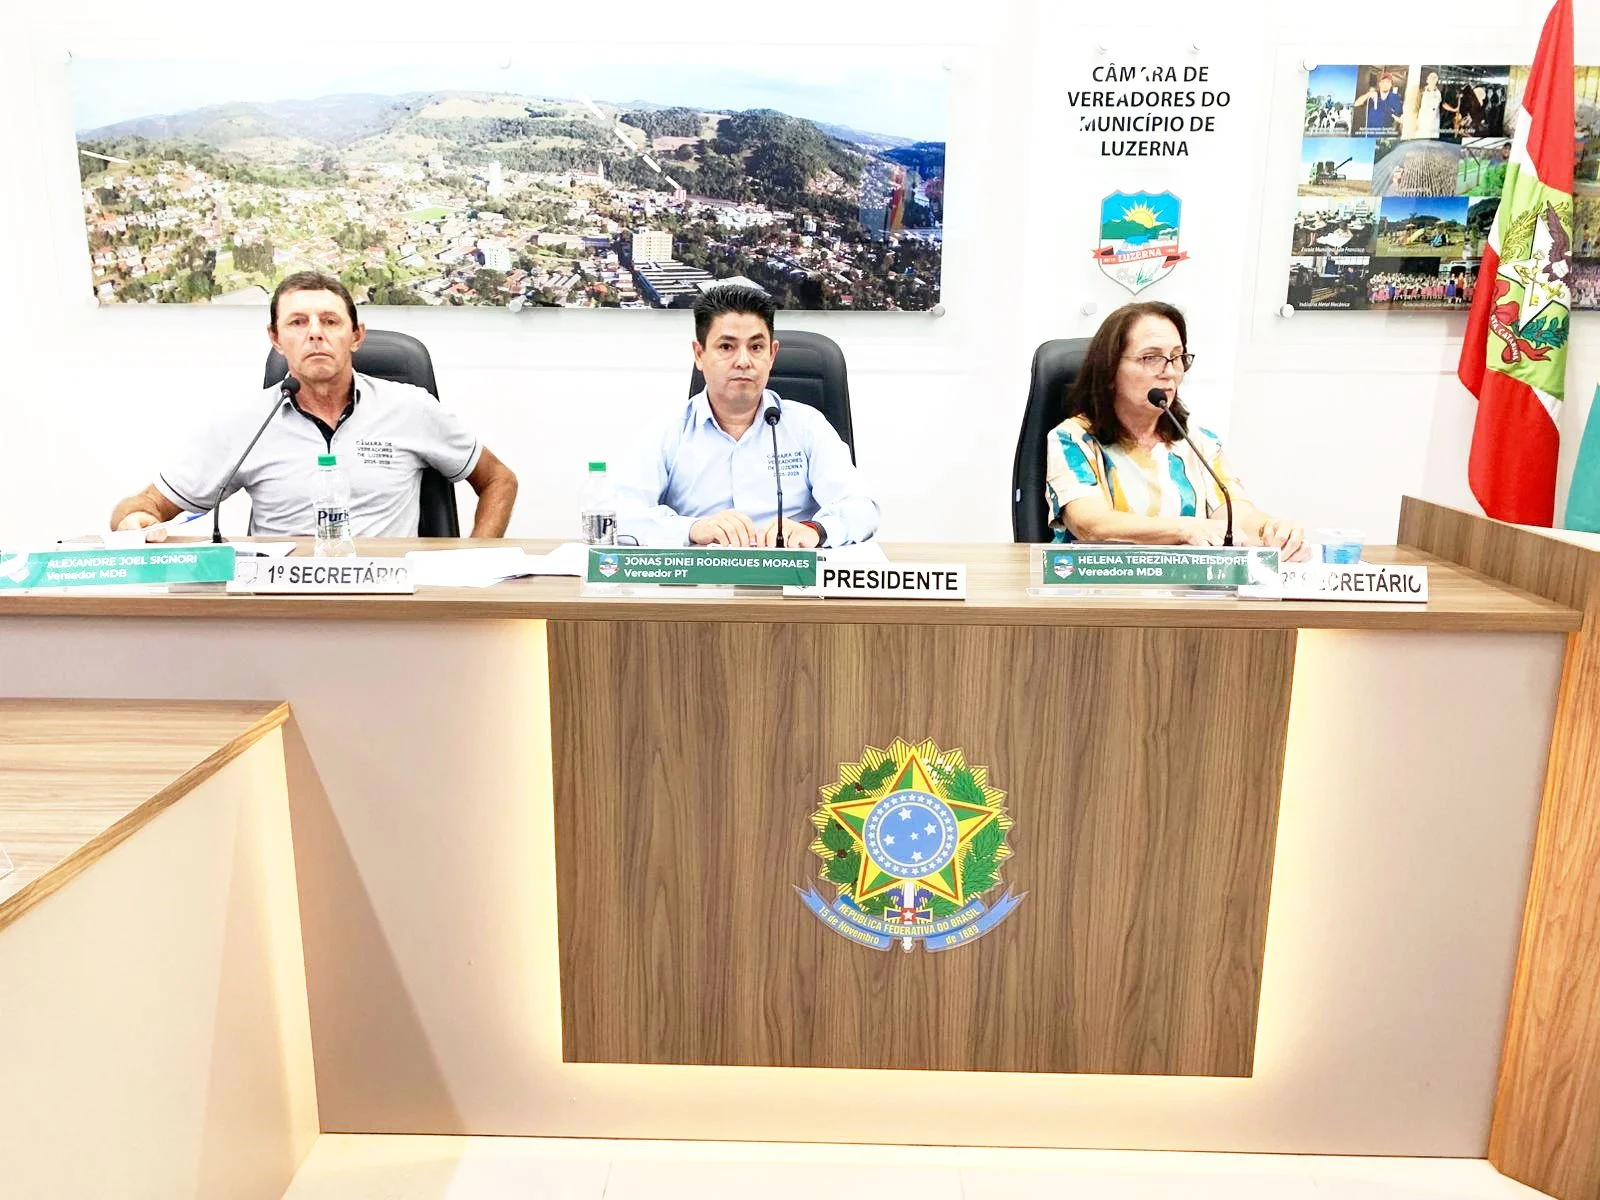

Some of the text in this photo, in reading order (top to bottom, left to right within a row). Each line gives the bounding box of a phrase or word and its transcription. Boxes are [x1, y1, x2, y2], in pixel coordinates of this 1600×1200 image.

[1092, 62, 1209, 82] CÂMRA DE
[1068, 91, 1231, 107] VEREADORES DO
[1189, 116, 1215, 132] DE
[1101, 140, 1189, 156] LUZERNA
[1118, 248, 1162, 261] LUZERNA
[47, 554, 198, 569] ALEXANDRE JOEL SIGNORI
[624, 556, 809, 569] JONAS DINEI RODRIGUES MORAES
[1078, 555, 1123, 565] HELENA
[1125, 555, 1189, 565] TEREZINHA
[46, 568, 128, 581] Vereador MDB
[624, 568, 688, 578] Vereador PT
[823, 569, 958, 590] PRESIDENTE
[1078, 567, 1163, 577] Vereadora MDB
[818, 906, 880, 945] 15 de Novembro
[883, 924, 936, 935] FEDERATIVA
[937, 921, 949, 932] DO
[950, 908, 981, 928] BRASIL
[945, 935, 957, 945] de
